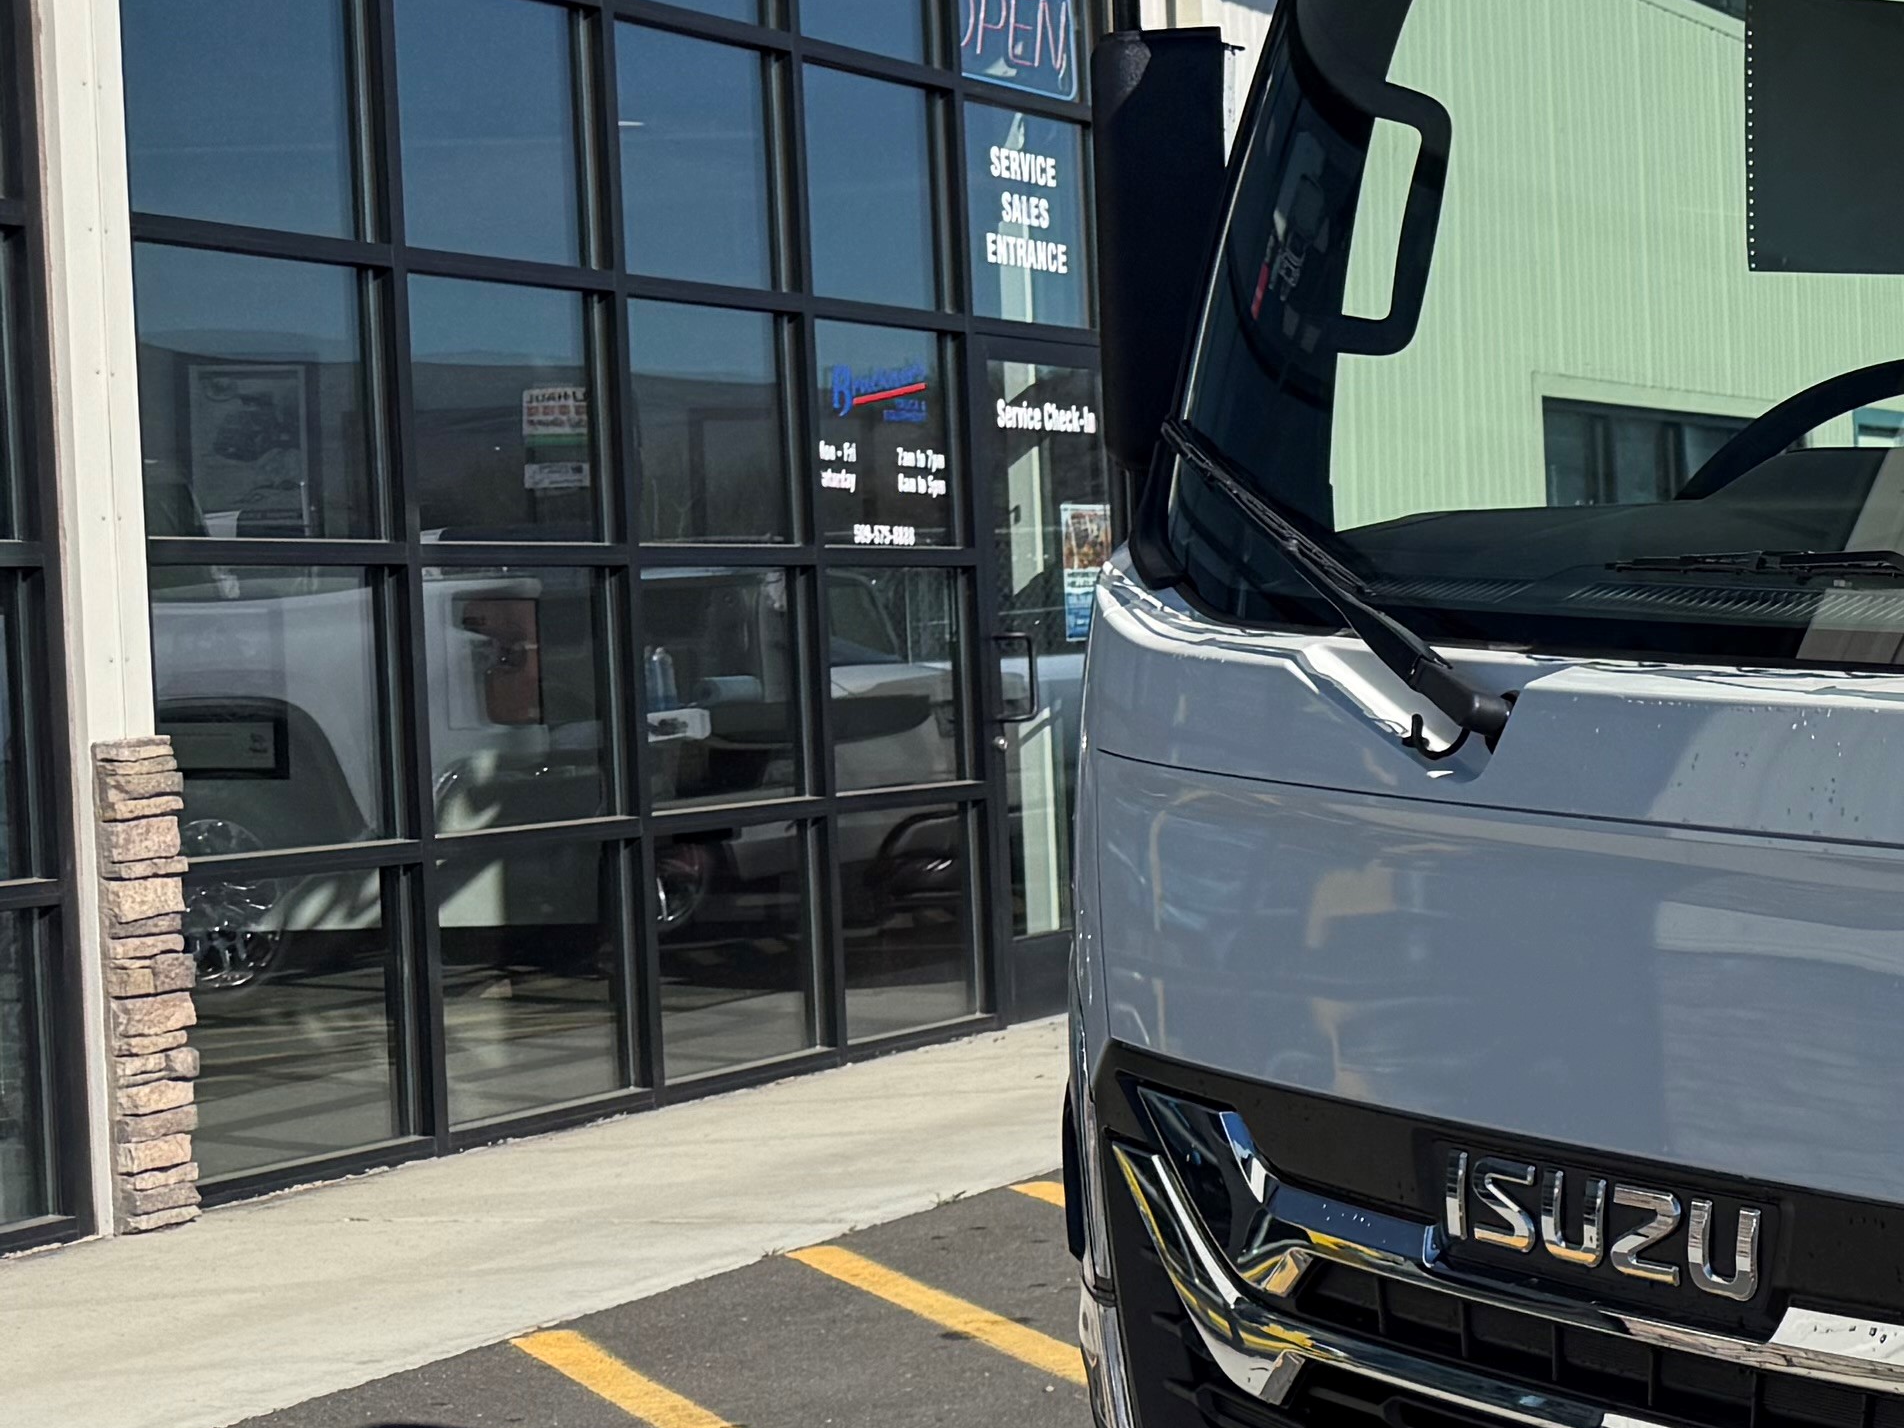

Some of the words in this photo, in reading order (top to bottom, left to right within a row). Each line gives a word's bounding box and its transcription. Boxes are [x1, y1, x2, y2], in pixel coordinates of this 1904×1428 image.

[989, 145, 1057, 188] SERVICE
[1001, 191, 1050, 229] SALES
[986, 232, 1068, 274] ENTRANCE
[996, 398, 1042, 430] Service
[1043, 402, 1096, 434] Check-In
[820, 468, 856, 493] aturday
[1446, 1149, 1761, 1302] ISUZU
